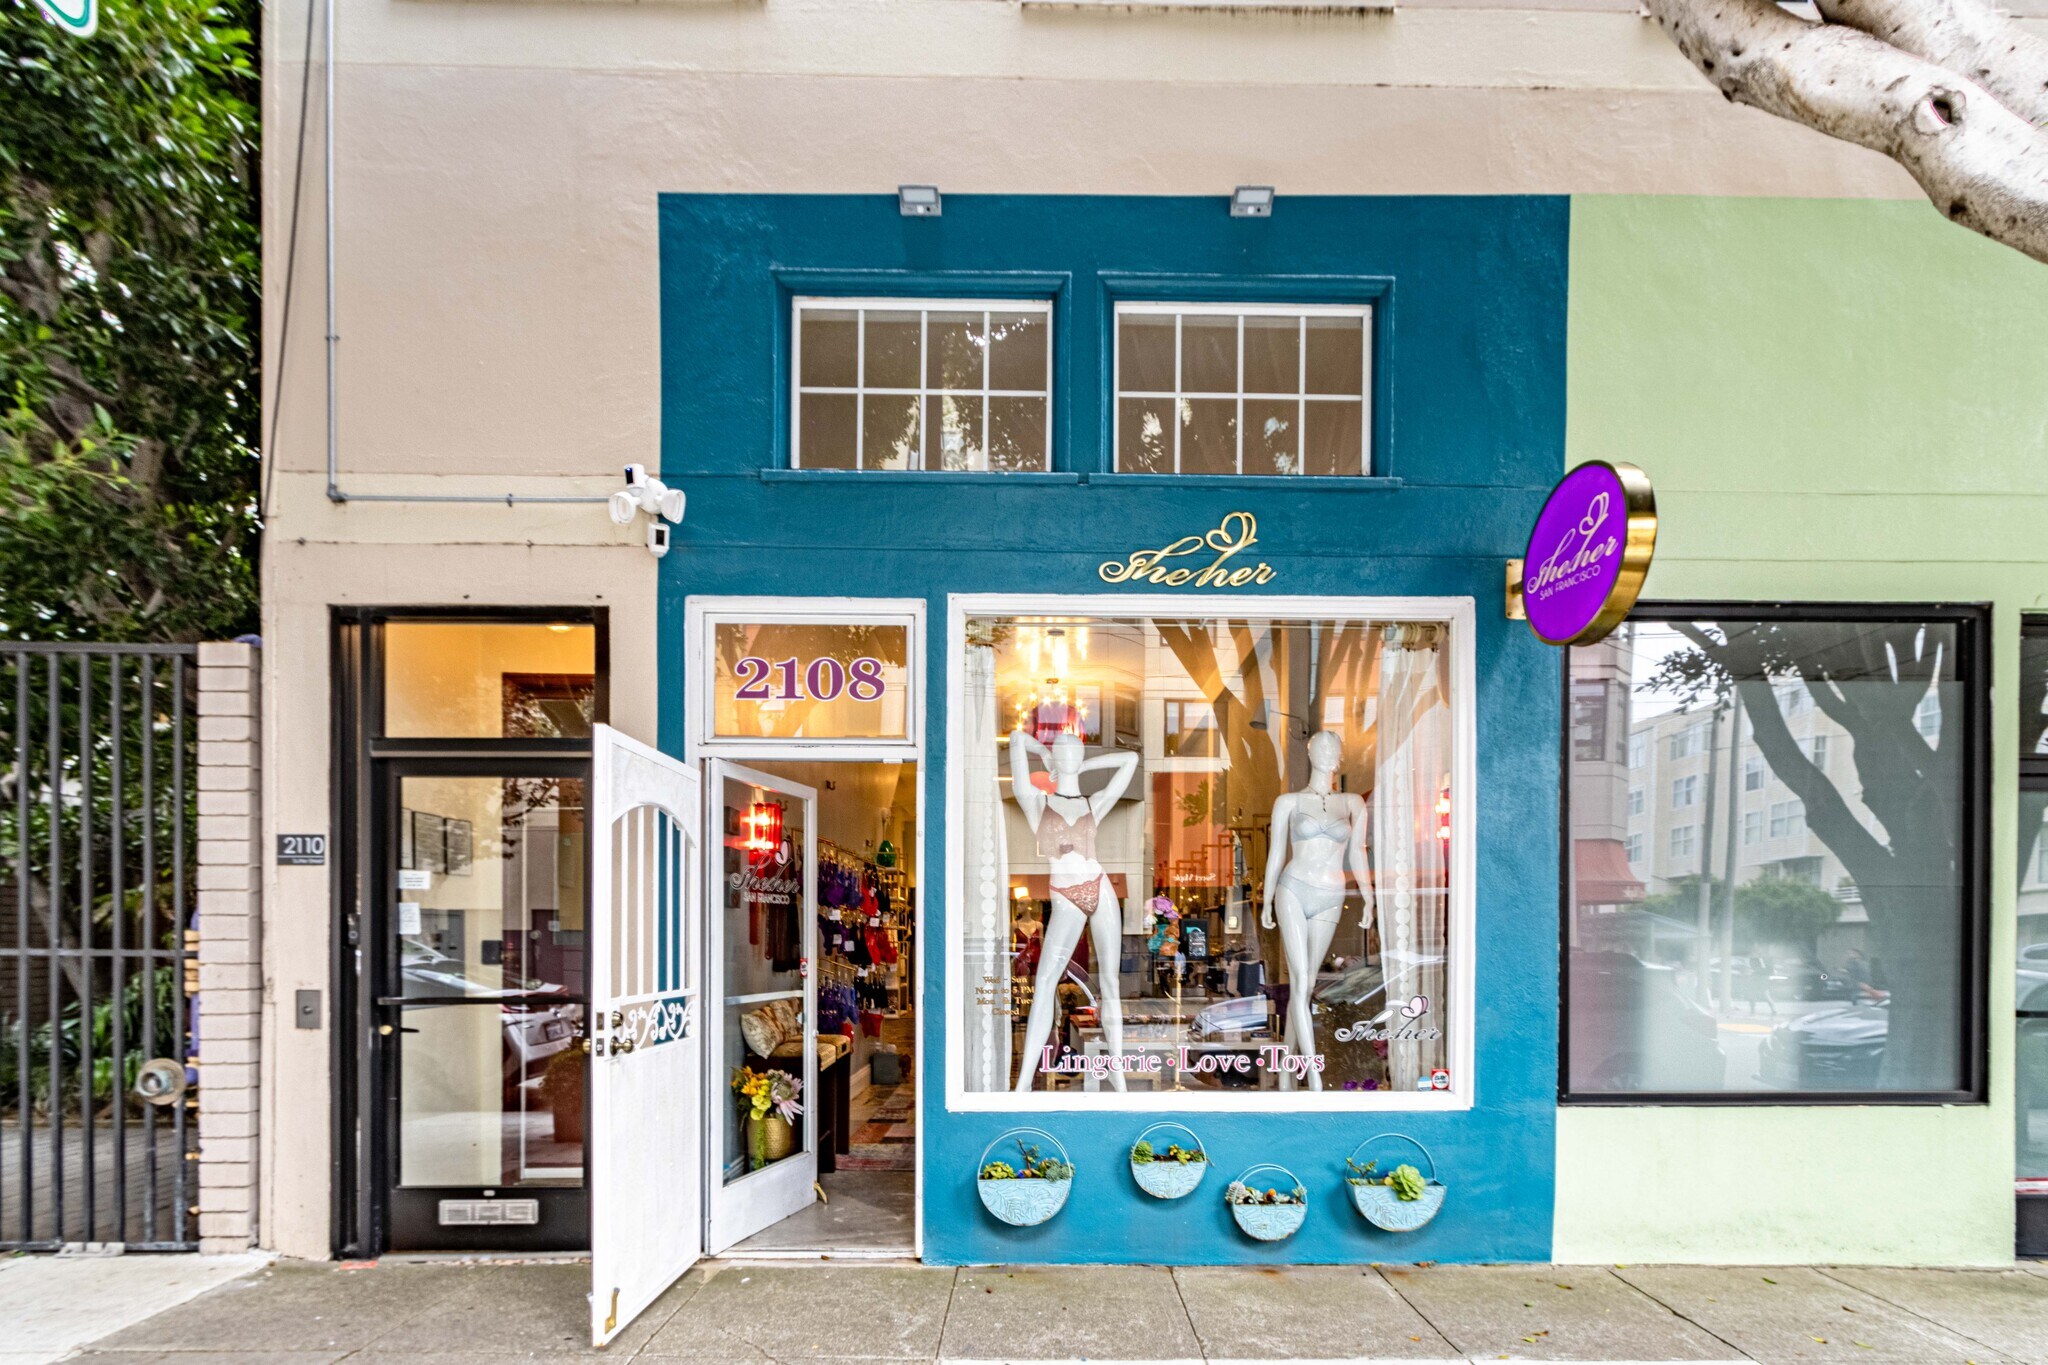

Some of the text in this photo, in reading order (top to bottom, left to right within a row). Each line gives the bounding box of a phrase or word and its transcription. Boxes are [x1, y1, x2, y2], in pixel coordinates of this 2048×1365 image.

[1539, 564, 1601, 601] SAN FRANCISCO
[734, 656, 886, 702] 2108
[283, 836, 325, 855] 2110
[743, 891, 791, 906] SAN FRANCISCO
[1011, 975, 1028, 984] Sun
[975, 986, 999, 995] Noon
[1012, 985, 1018, 994] 5
[1020, 985, 1035, 994] PM
[976, 997, 997, 1006] Mon
[1038, 1045, 1326, 1081] Lingerie Love Toys
